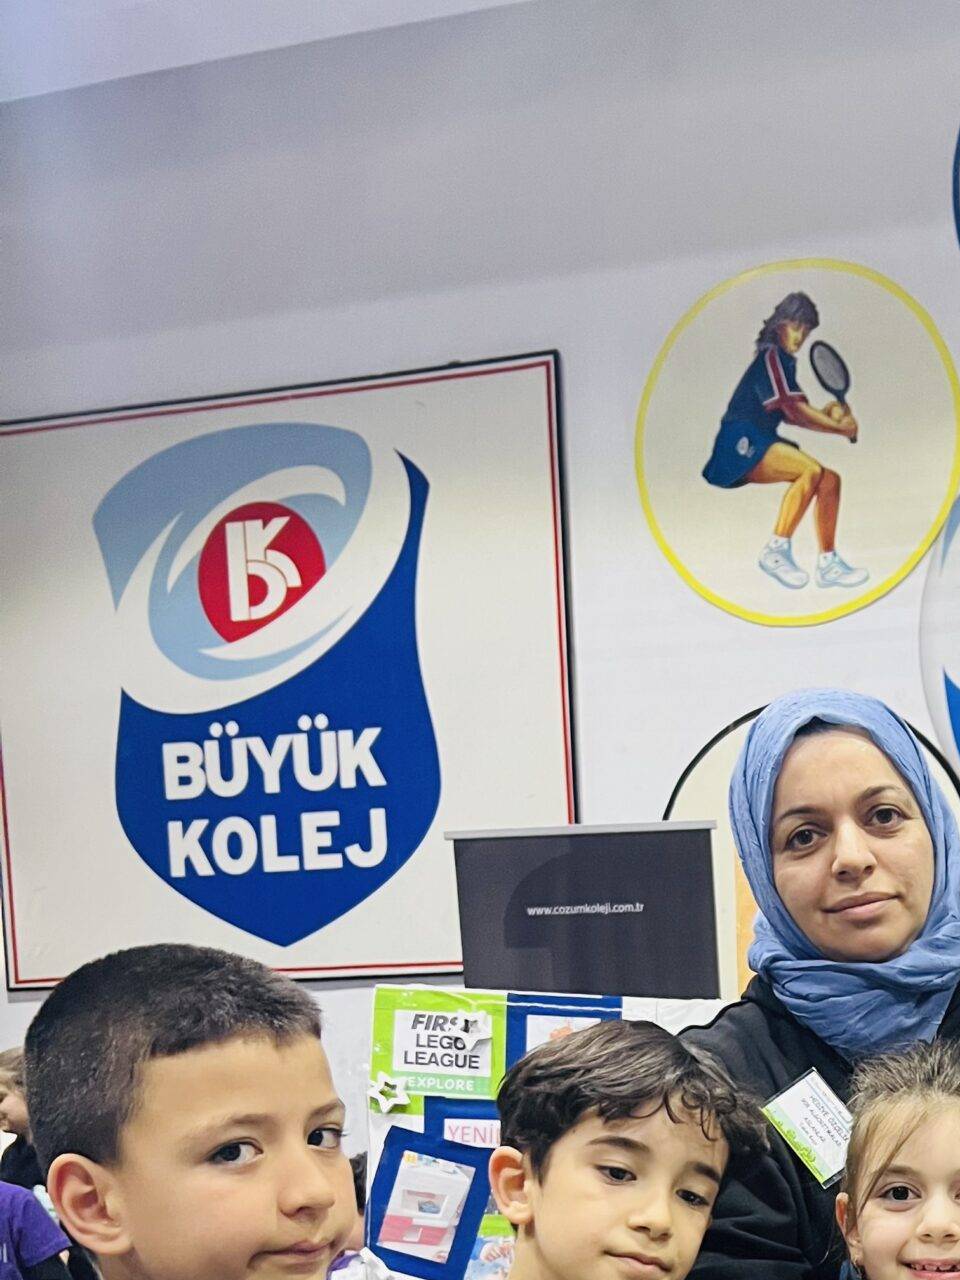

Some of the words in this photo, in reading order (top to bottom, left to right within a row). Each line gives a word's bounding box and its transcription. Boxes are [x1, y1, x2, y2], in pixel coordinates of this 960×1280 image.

[162, 713, 387, 801] BÜYÜK
[167, 807, 388, 879] KOLEJ
[527, 902, 645, 916] www.cozumkoleji.com.tr
[415, 1033, 467, 1051] LEGO
[403, 1050, 480, 1070] LEAGUE
[408, 1077, 475, 1092] EXPLORE
